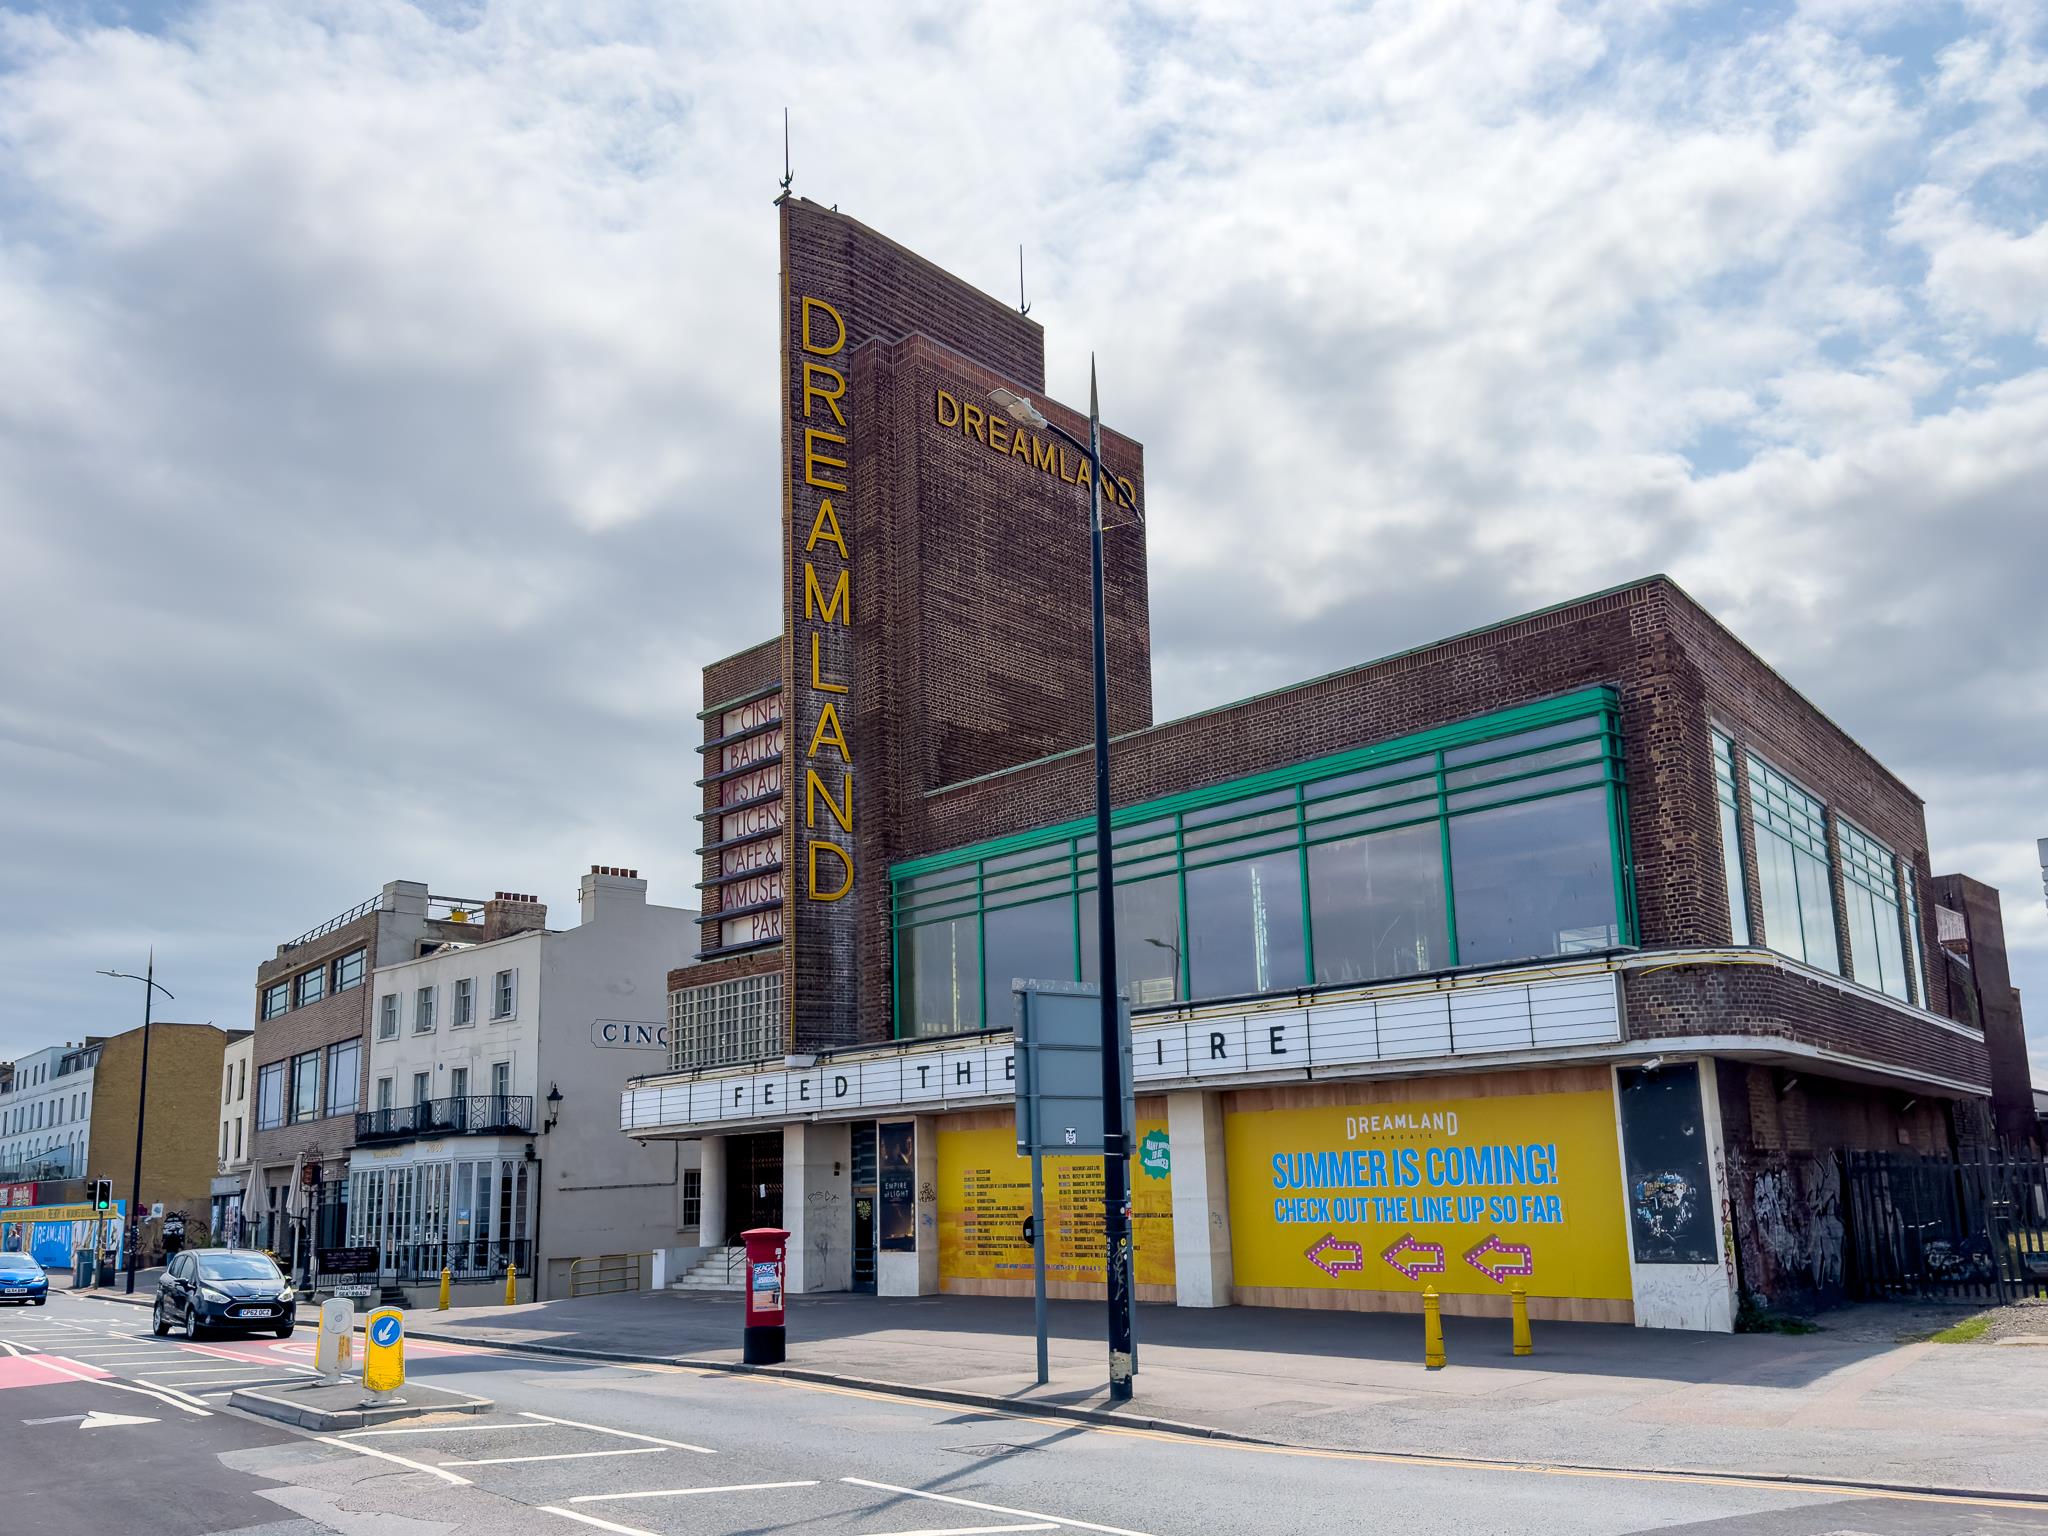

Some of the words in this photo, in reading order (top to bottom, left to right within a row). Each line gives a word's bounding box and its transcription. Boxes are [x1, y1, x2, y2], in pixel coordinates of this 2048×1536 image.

[937, 389, 1137, 508] DREAMLAND
[802, 296, 855, 901] DREAMLAND
[723, 764, 784, 806] RESTAU
[724, 843, 762, 875] CAFE
[765, 838, 777, 864] &
[752, 907, 784, 940] PAR
[734, 1075, 848, 1108] FEED
[917, 1055, 1015, 1089] THE
[1346, 1112, 1458, 1140] DREAMLAND
[1272, 1150, 1389, 1189] SUMMER
[1392, 1147, 1421, 1188] IS
[1426, 1144, 1559, 1188] COMING!
[885, 1182, 908, 1190] EMPIRE
[890, 1190, 909, 1198] LIGHT
[1274, 1198, 1331, 1223] CHECK
[1333, 1197, 1370, 1223] OUT
[1372, 1197, 1410, 1223] THE
[1411, 1197, 1454, 1223] LINE
[1457, 1196, 1485, 1223] UP
[1489, 1196, 1518, 1223] SO
[1522, 1195, 1563, 1223] FAR
